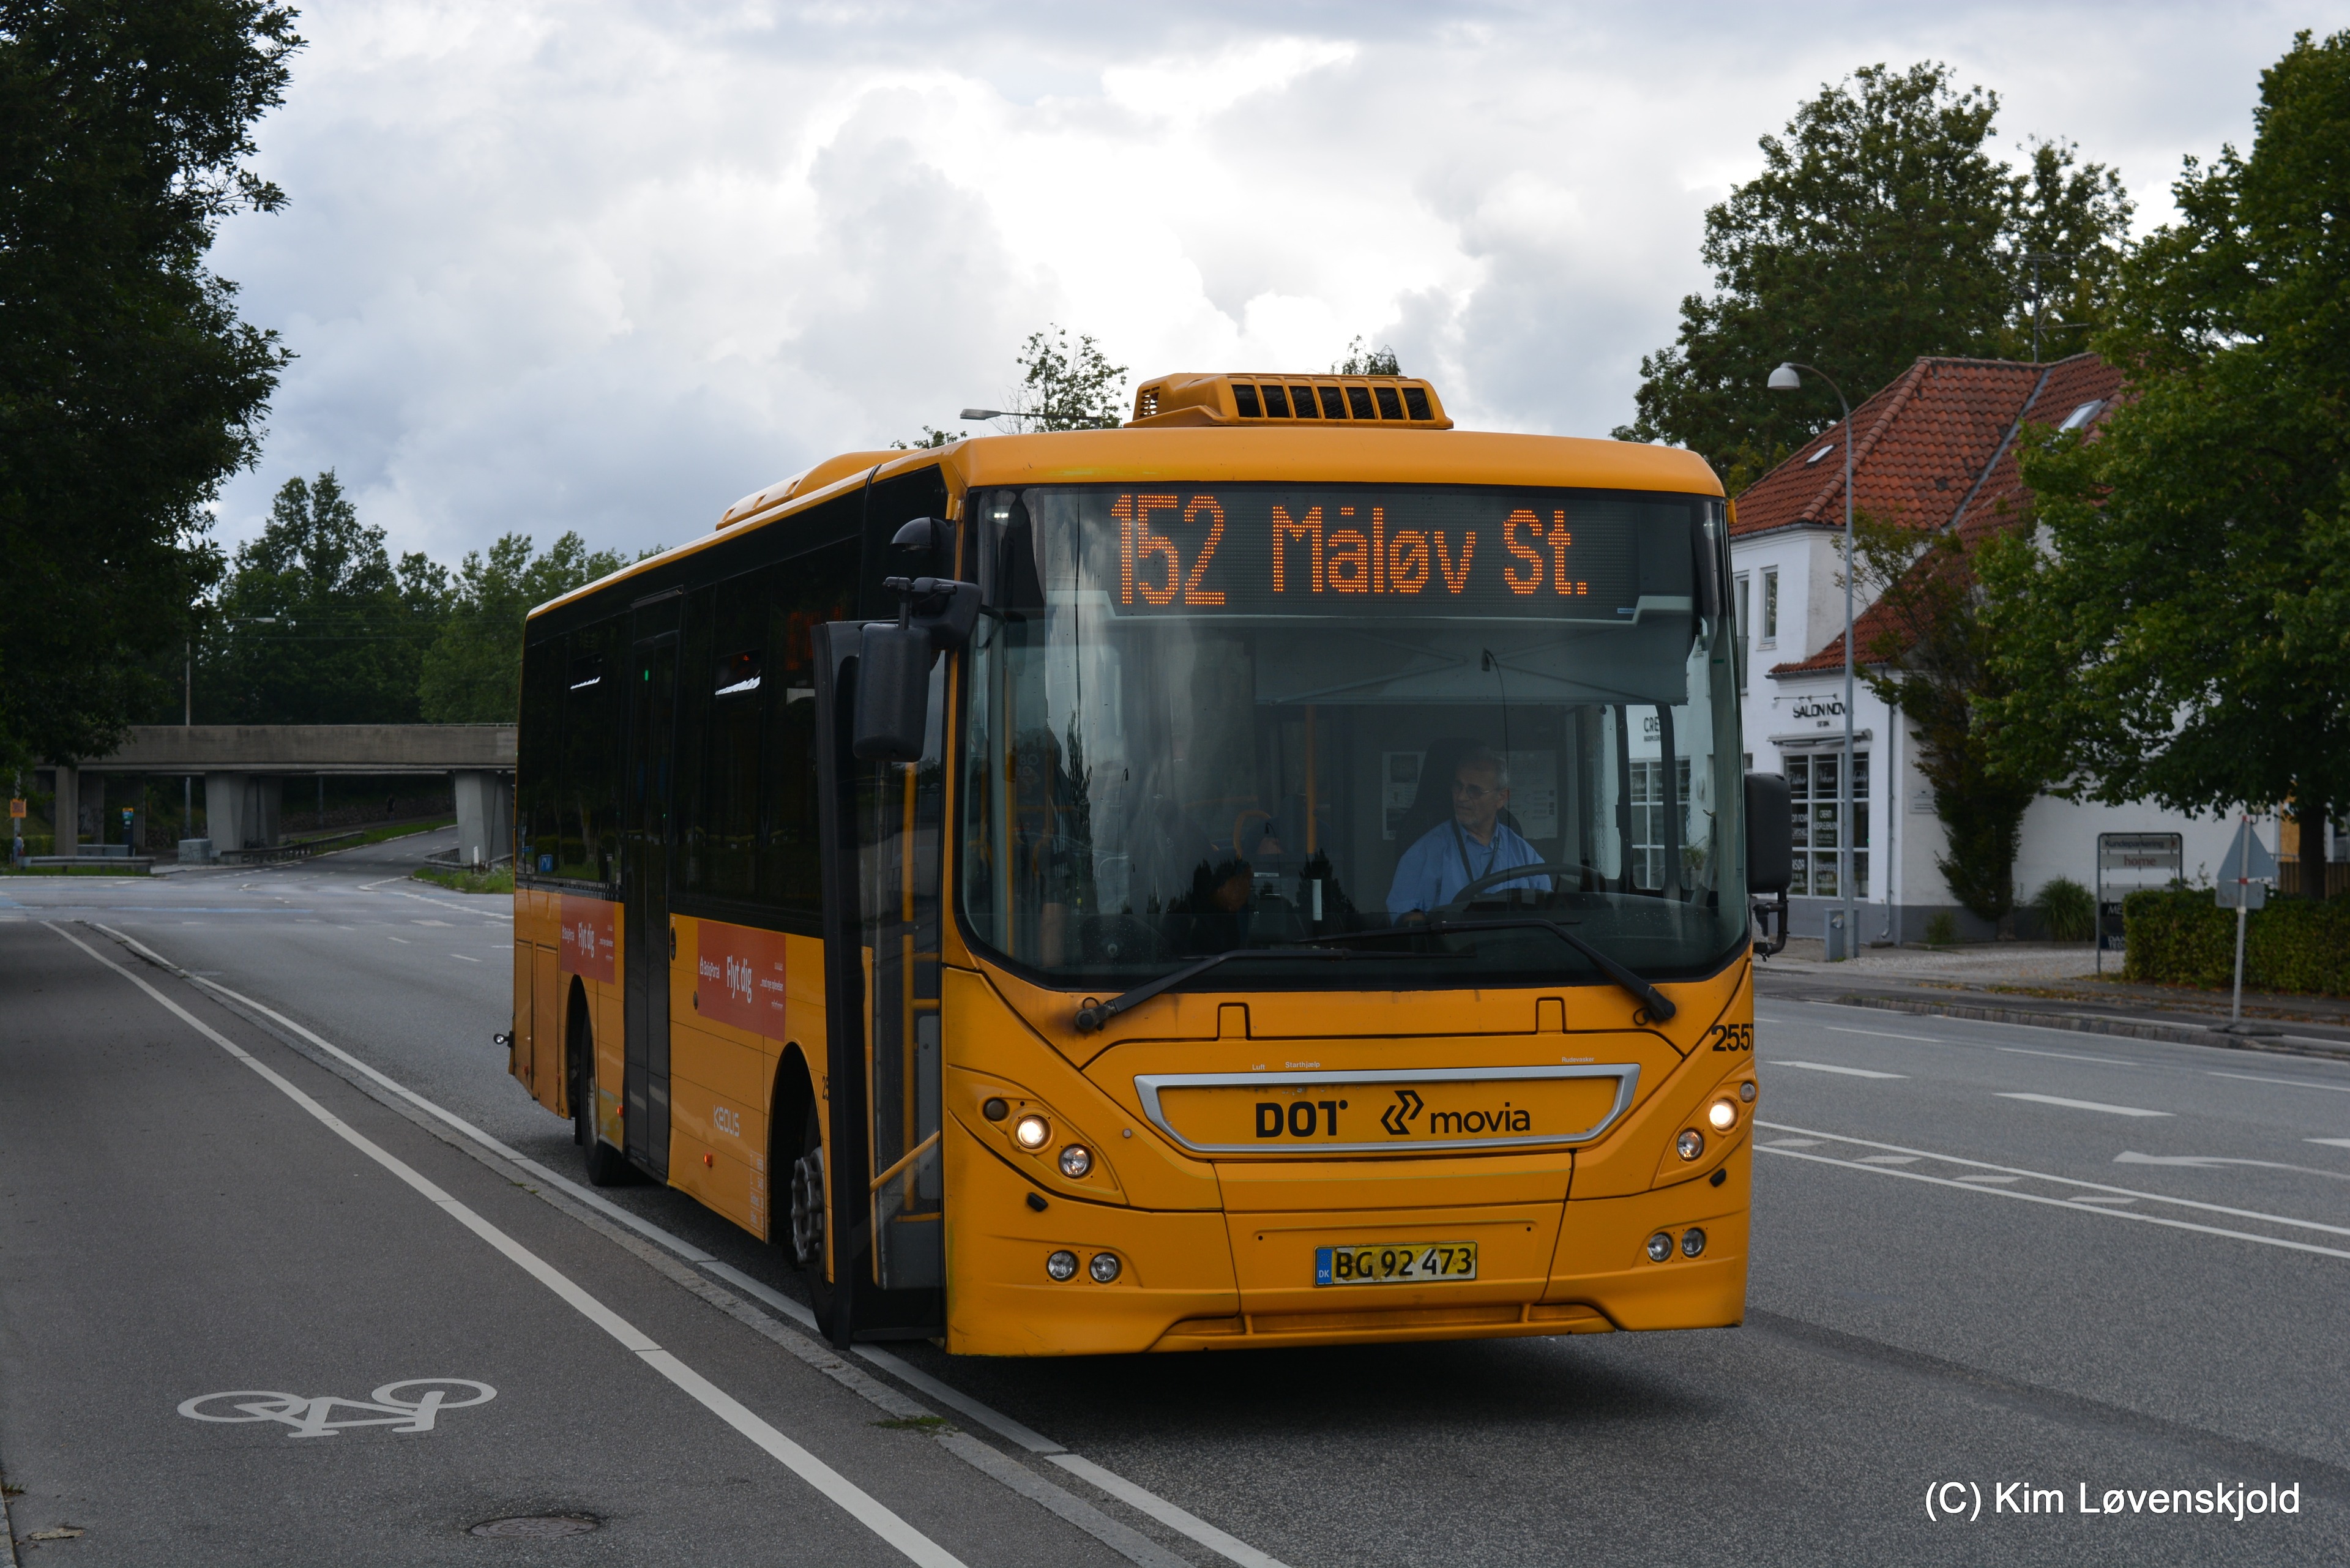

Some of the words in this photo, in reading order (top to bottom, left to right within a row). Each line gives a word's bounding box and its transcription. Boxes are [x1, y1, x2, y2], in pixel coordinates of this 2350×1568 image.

[1111, 495, 1225, 605] 152
[1273, 506, 1477, 594] Måløv
[1503, 510, 1587, 595] St.
[1826, 702, 1846, 715] NOV
[2105, 839, 2165, 849] Kundeparkering
[2124, 854, 2156, 866] home
[726, 955, 740, 999] Flyt
[740, 958, 752, 1004] dig
[1255, 1100, 1348, 1138] DOT
[1430, 1102, 1531, 1134] movia
[1318, 1269, 1329, 1278] DK
[1336, 1251, 1373, 1278] BG
[1381, 1250, 1414, 1277] 92
[1422, 1247, 1472, 1275] 473
